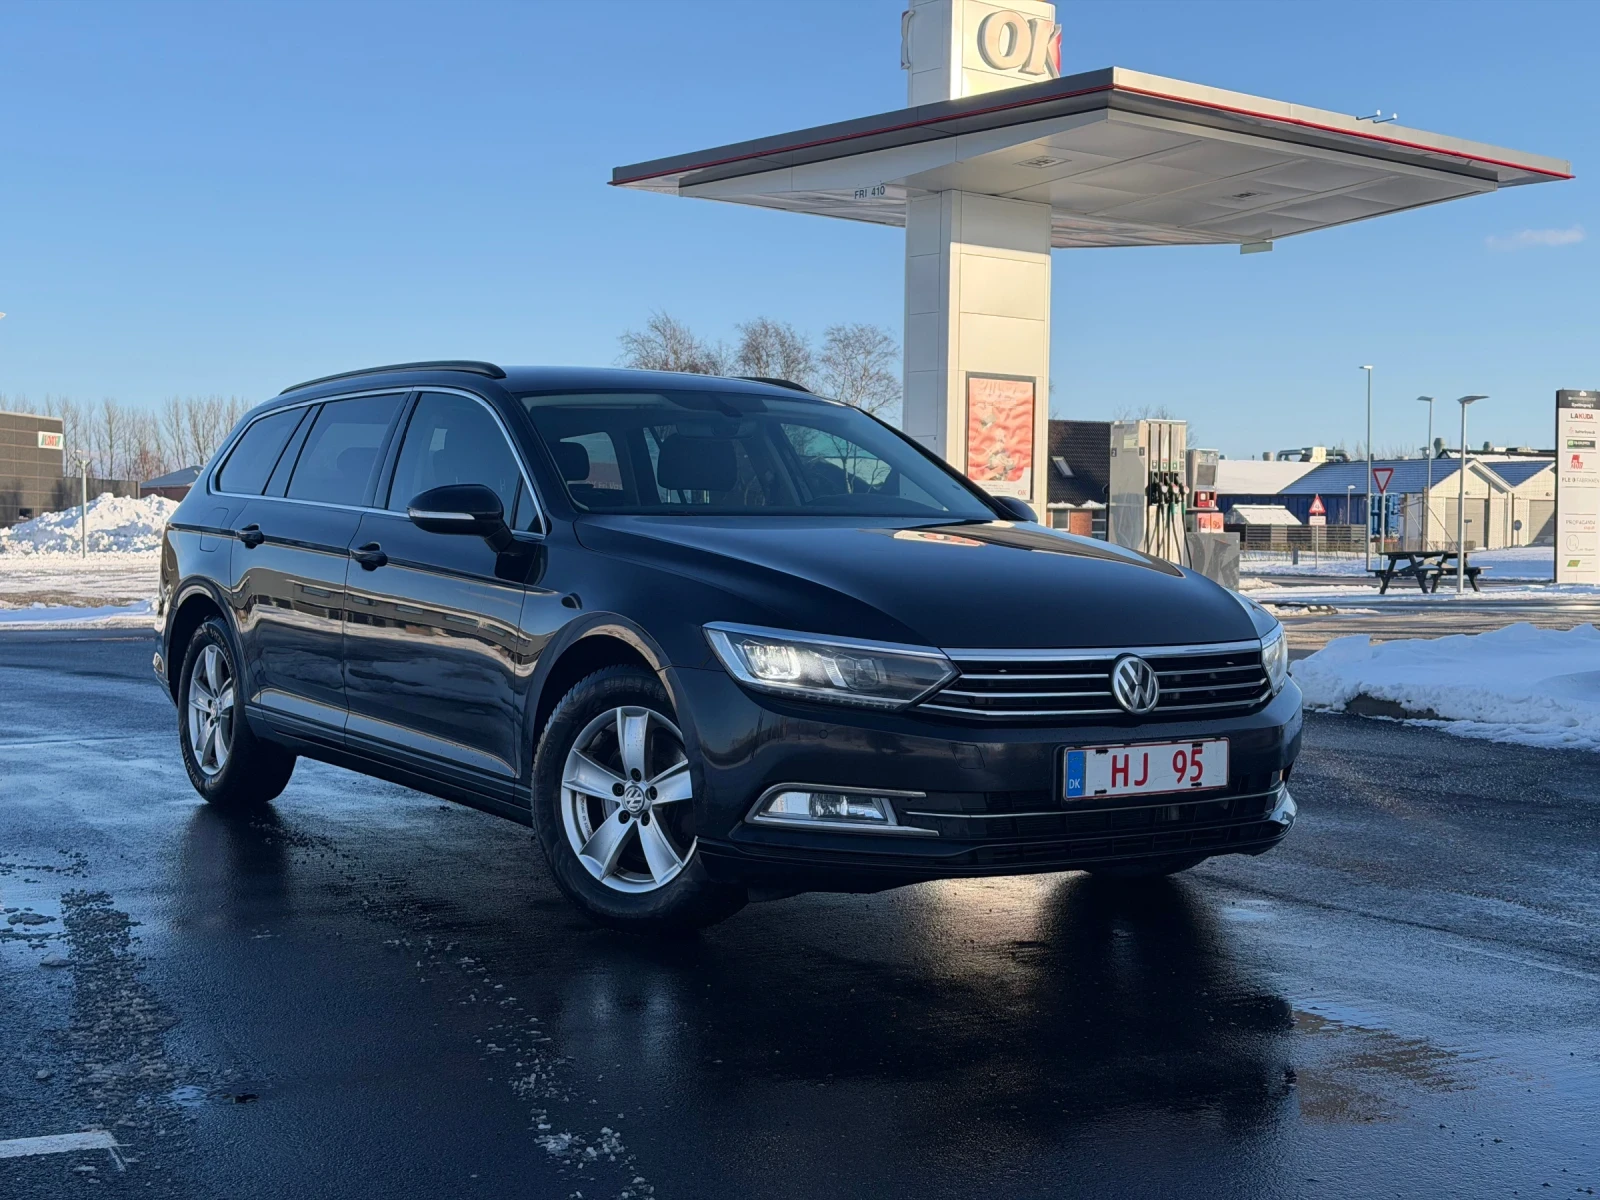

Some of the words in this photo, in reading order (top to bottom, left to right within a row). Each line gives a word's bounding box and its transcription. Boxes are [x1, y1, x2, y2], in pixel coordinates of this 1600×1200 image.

[977, 9, 1062, 79] OK
[854, 189, 868, 199] FRI
[871, 185, 886, 196] 410
[1570, 412, 1594, 420] LAKUDA
[1068, 779, 1081, 789] DK
[1111, 752, 1149, 788] HJ
[1172, 748, 1204, 784] 95
